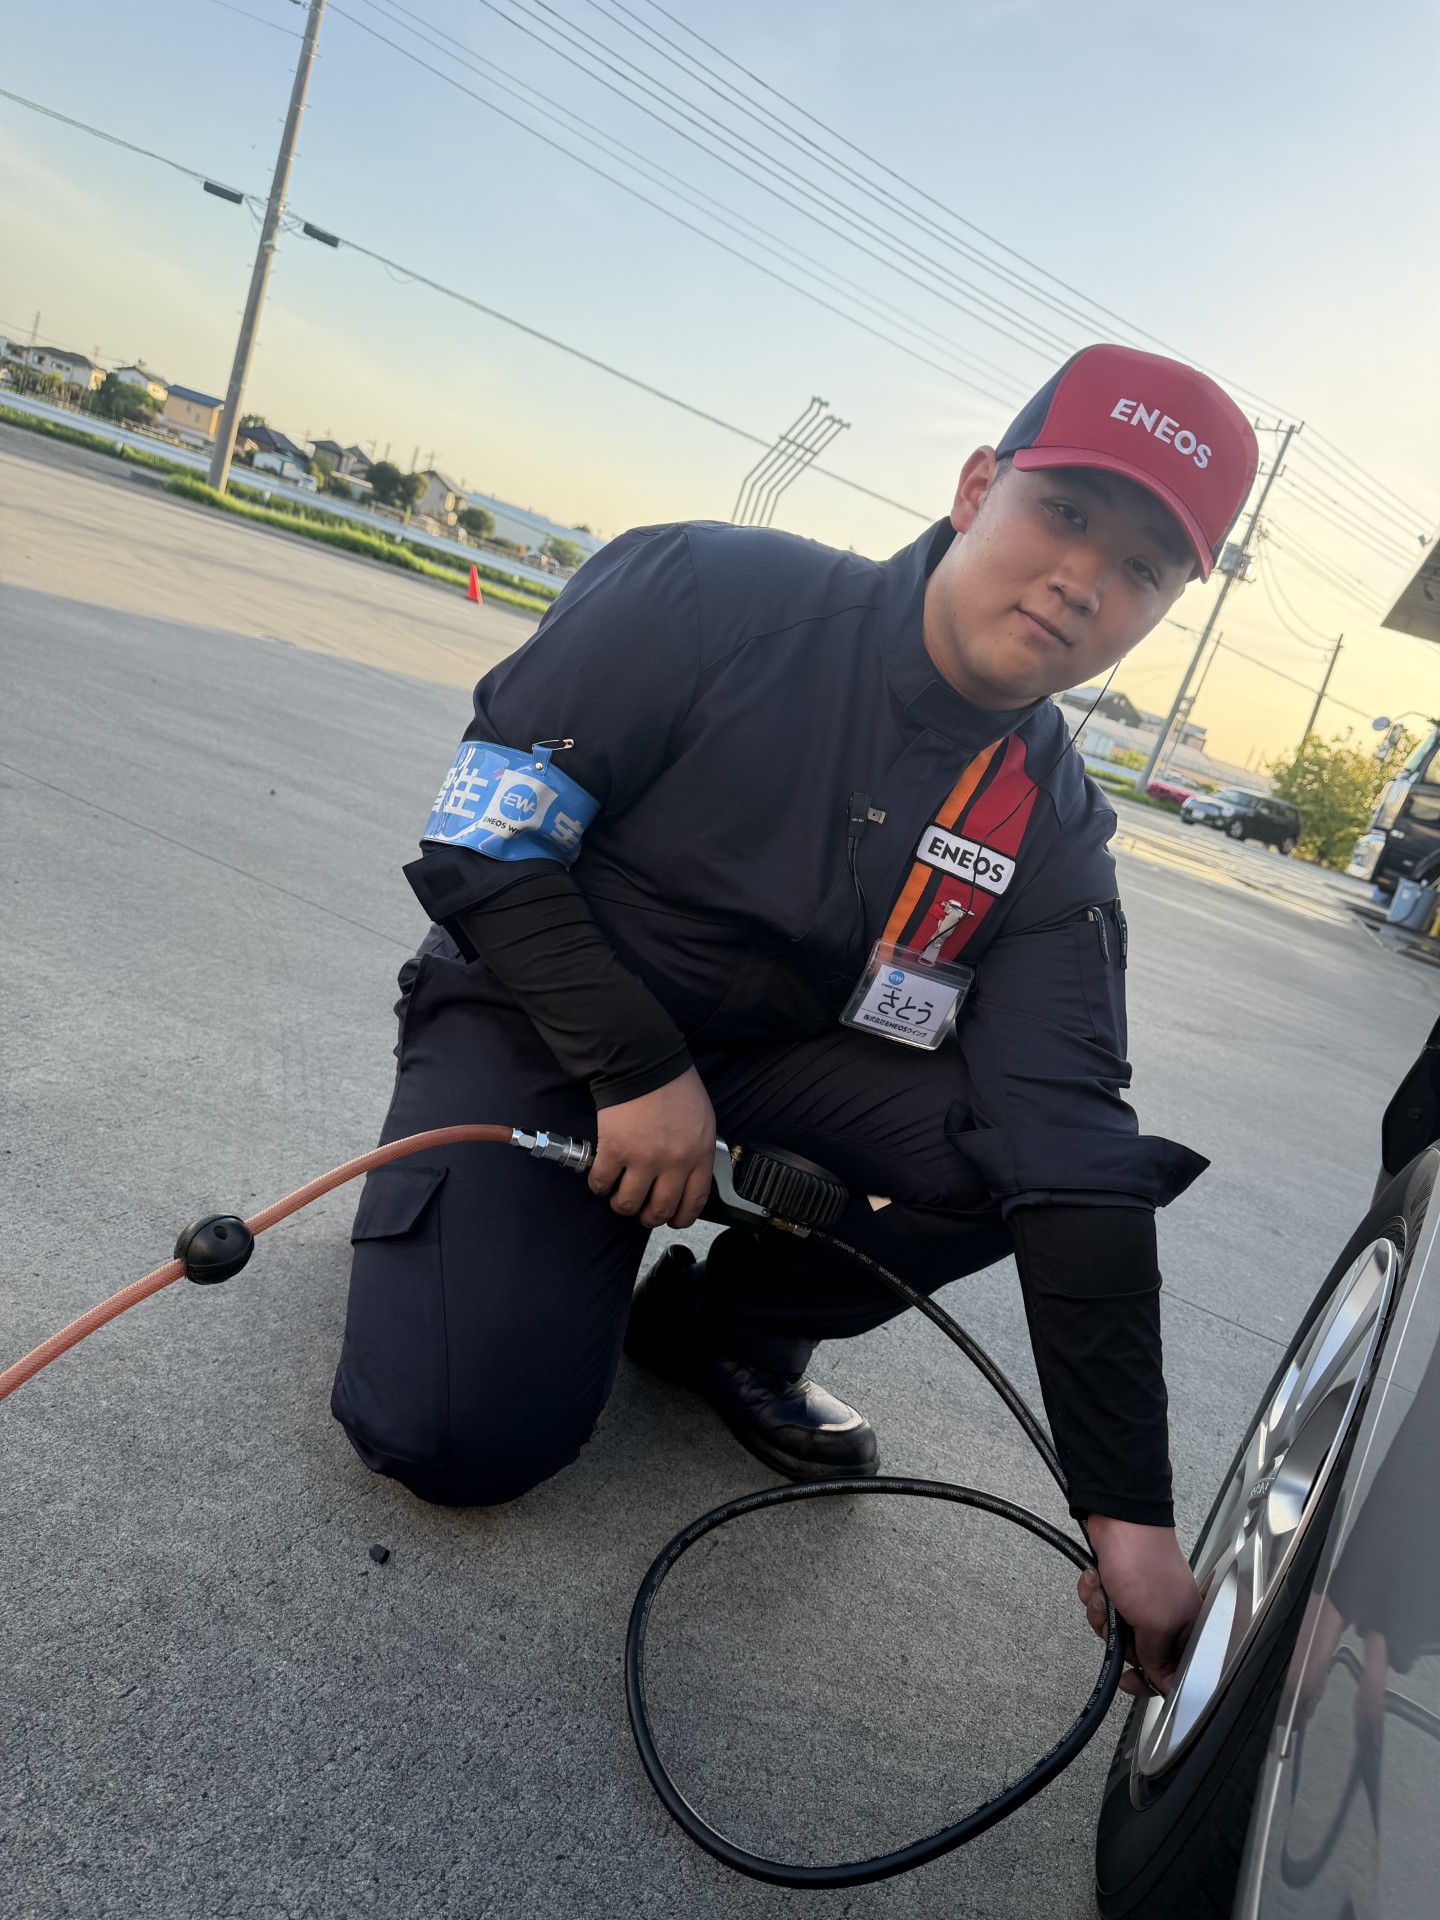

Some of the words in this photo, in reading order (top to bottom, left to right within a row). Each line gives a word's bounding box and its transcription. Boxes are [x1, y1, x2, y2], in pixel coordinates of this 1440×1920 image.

[1110, 398, 1212, 469] ENEOS
[483, 817, 507, 829] ENEOS
[927, 836, 1005, 883] ENEOS
[877, 990, 934, 1025] さとう
[878, 1265, 902, 1286] WONDER
[903, 1285, 919, 1298] ITALY
[735, 1496, 763, 1511] WONDER
[767, 1491, 784, 1501] ITALY
[792, 1485, 821, 1495] WONDER
[826, 1483, 843, 1491] ITALY
[912, 1484, 942, 1494] WONDER
[947, 1489, 965, 1498] ITALY
[973, 1495, 1002, 1511] WONDER
[1006, 1507, 1024, 1520] ITALY
[1031, 1520, 1059, 1541] WONDER
[1061, 1541, 1079, 1556] ITALY
[1108, 1633, 1116, 1652] ITALY
